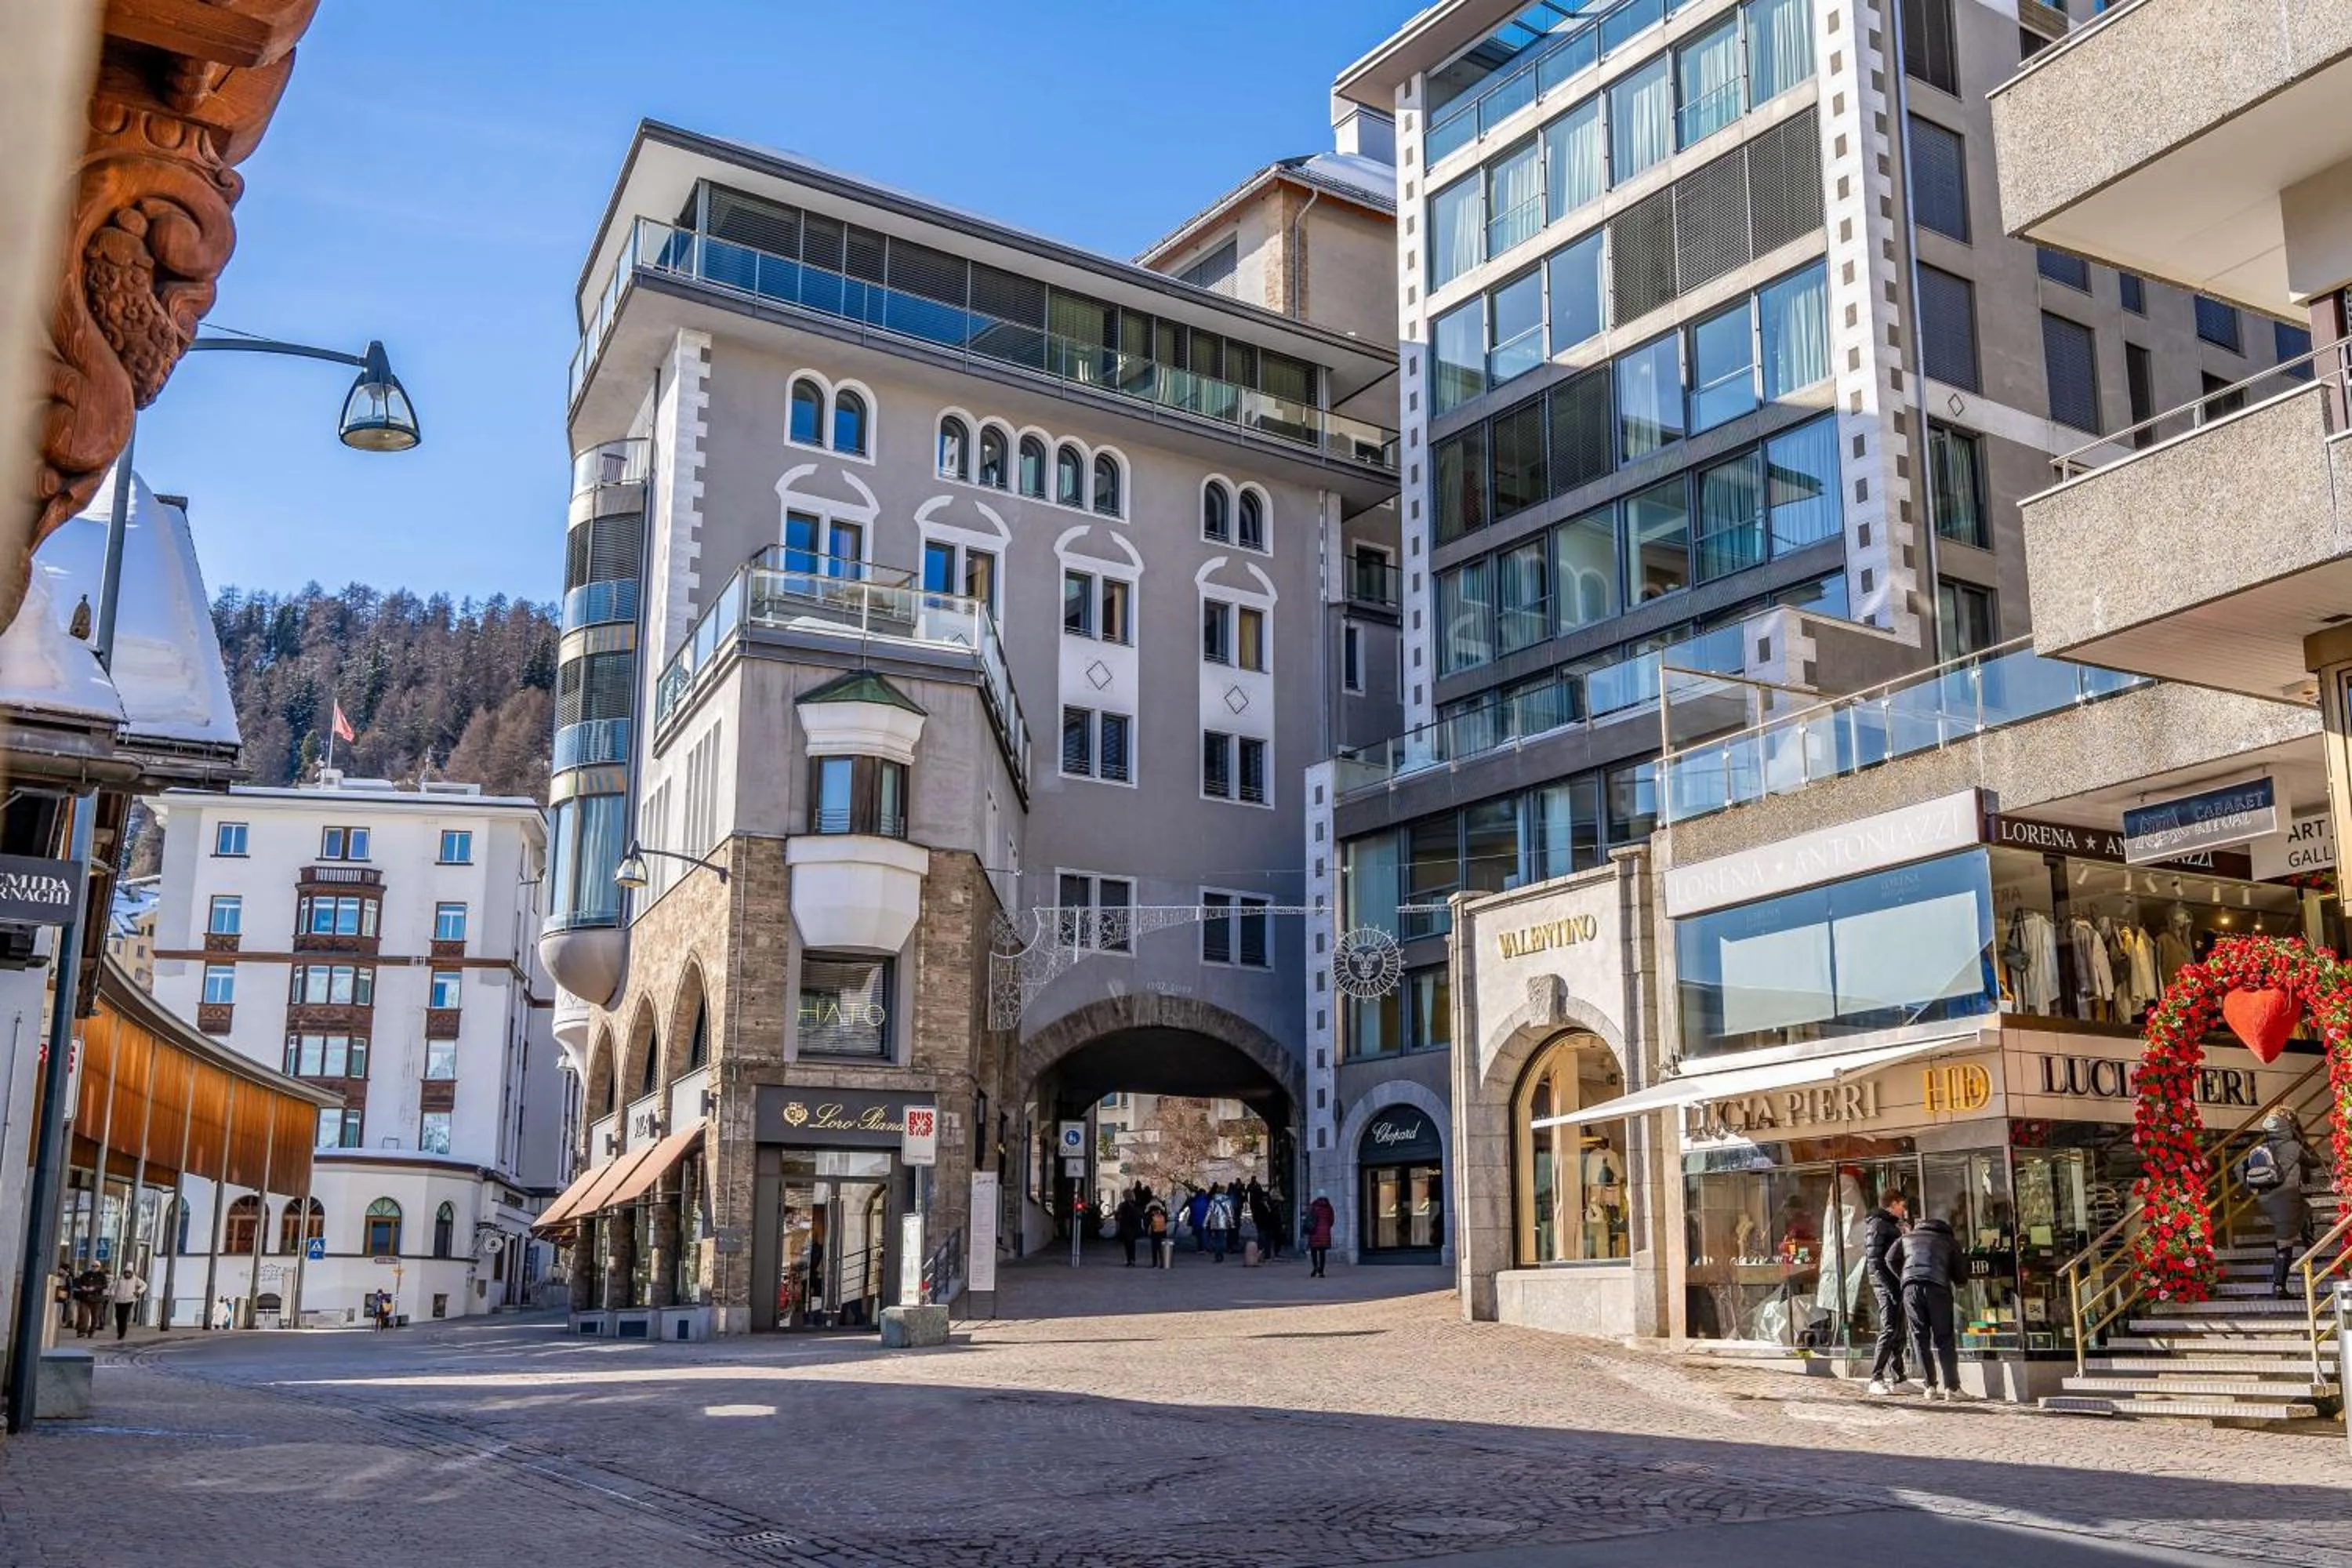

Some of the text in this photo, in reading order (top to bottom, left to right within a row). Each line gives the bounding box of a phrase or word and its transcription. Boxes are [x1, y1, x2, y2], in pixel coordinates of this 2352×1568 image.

[2001, 821, 2077, 849] LORENA
[2288, 820, 2325, 843] ART
[1674, 806, 1959, 905] LORENA ANTONIAZZI
[1498, 914, 1597, 959] VALENTINO
[798, 1002, 885, 1026] HATO
[2041, 1056, 2131, 1098] LUCI
[808, 1103, 903, 1131] Loro Piana
[909, 1111, 933, 1127] BUS
[1685, 1096, 1777, 1138] LUCIA
[1785, 1081, 1879, 1127] PIERI
[909, 1125, 933, 1137] STOP
[1372, 1120, 1421, 1146] Chopard
[1971, 1260, 1989, 1274] HD
